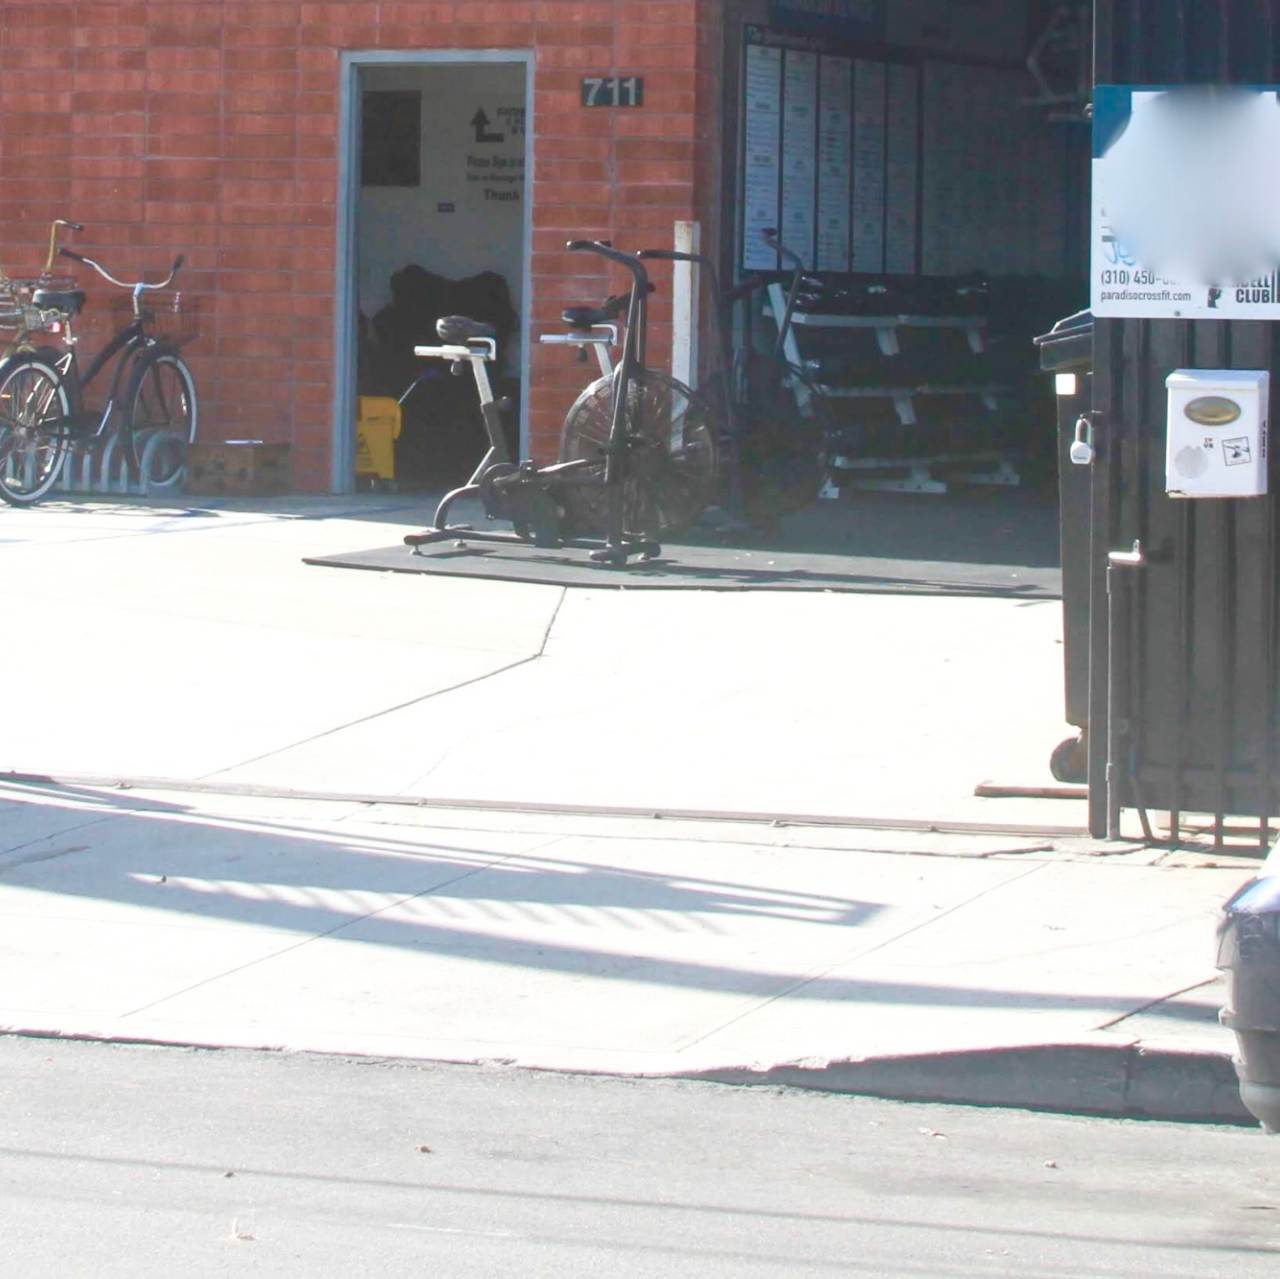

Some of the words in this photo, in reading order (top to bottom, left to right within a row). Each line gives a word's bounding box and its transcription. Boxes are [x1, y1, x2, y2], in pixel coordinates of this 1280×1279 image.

[582, 78, 638, 106] 711
[1100, 270, 1130, 287] (310)
[1100, 290, 1192, 303] paradisocrossfit.com
[1235, 288, 1270, 304] CLUB
